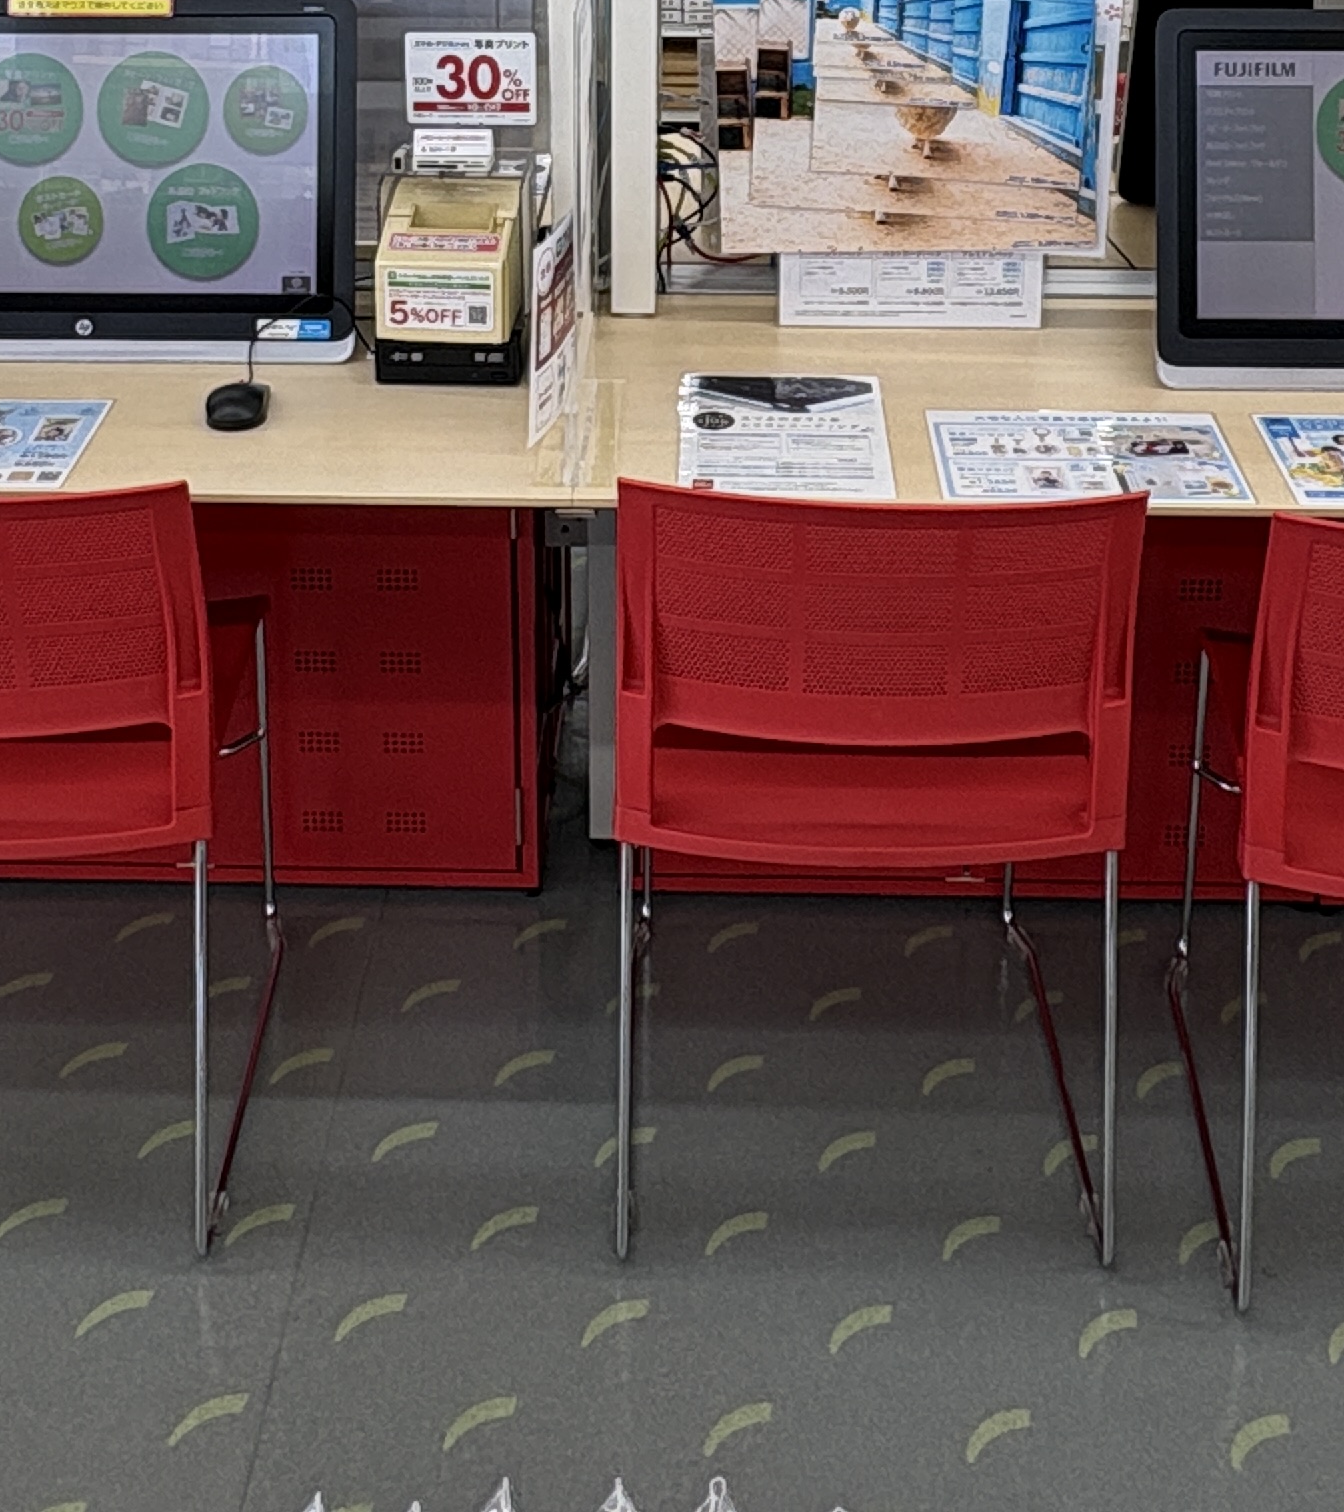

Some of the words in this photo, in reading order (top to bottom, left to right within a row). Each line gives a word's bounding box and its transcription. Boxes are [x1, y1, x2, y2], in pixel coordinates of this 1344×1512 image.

[474, 39, 530, 50] 写真プリント
[436, 54, 501, 100] 30
[1213, 62, 1296, 78] FUJIFILM
[502, 89, 531, 101] OFF
[389, 299, 464, 326] 5%OFF
